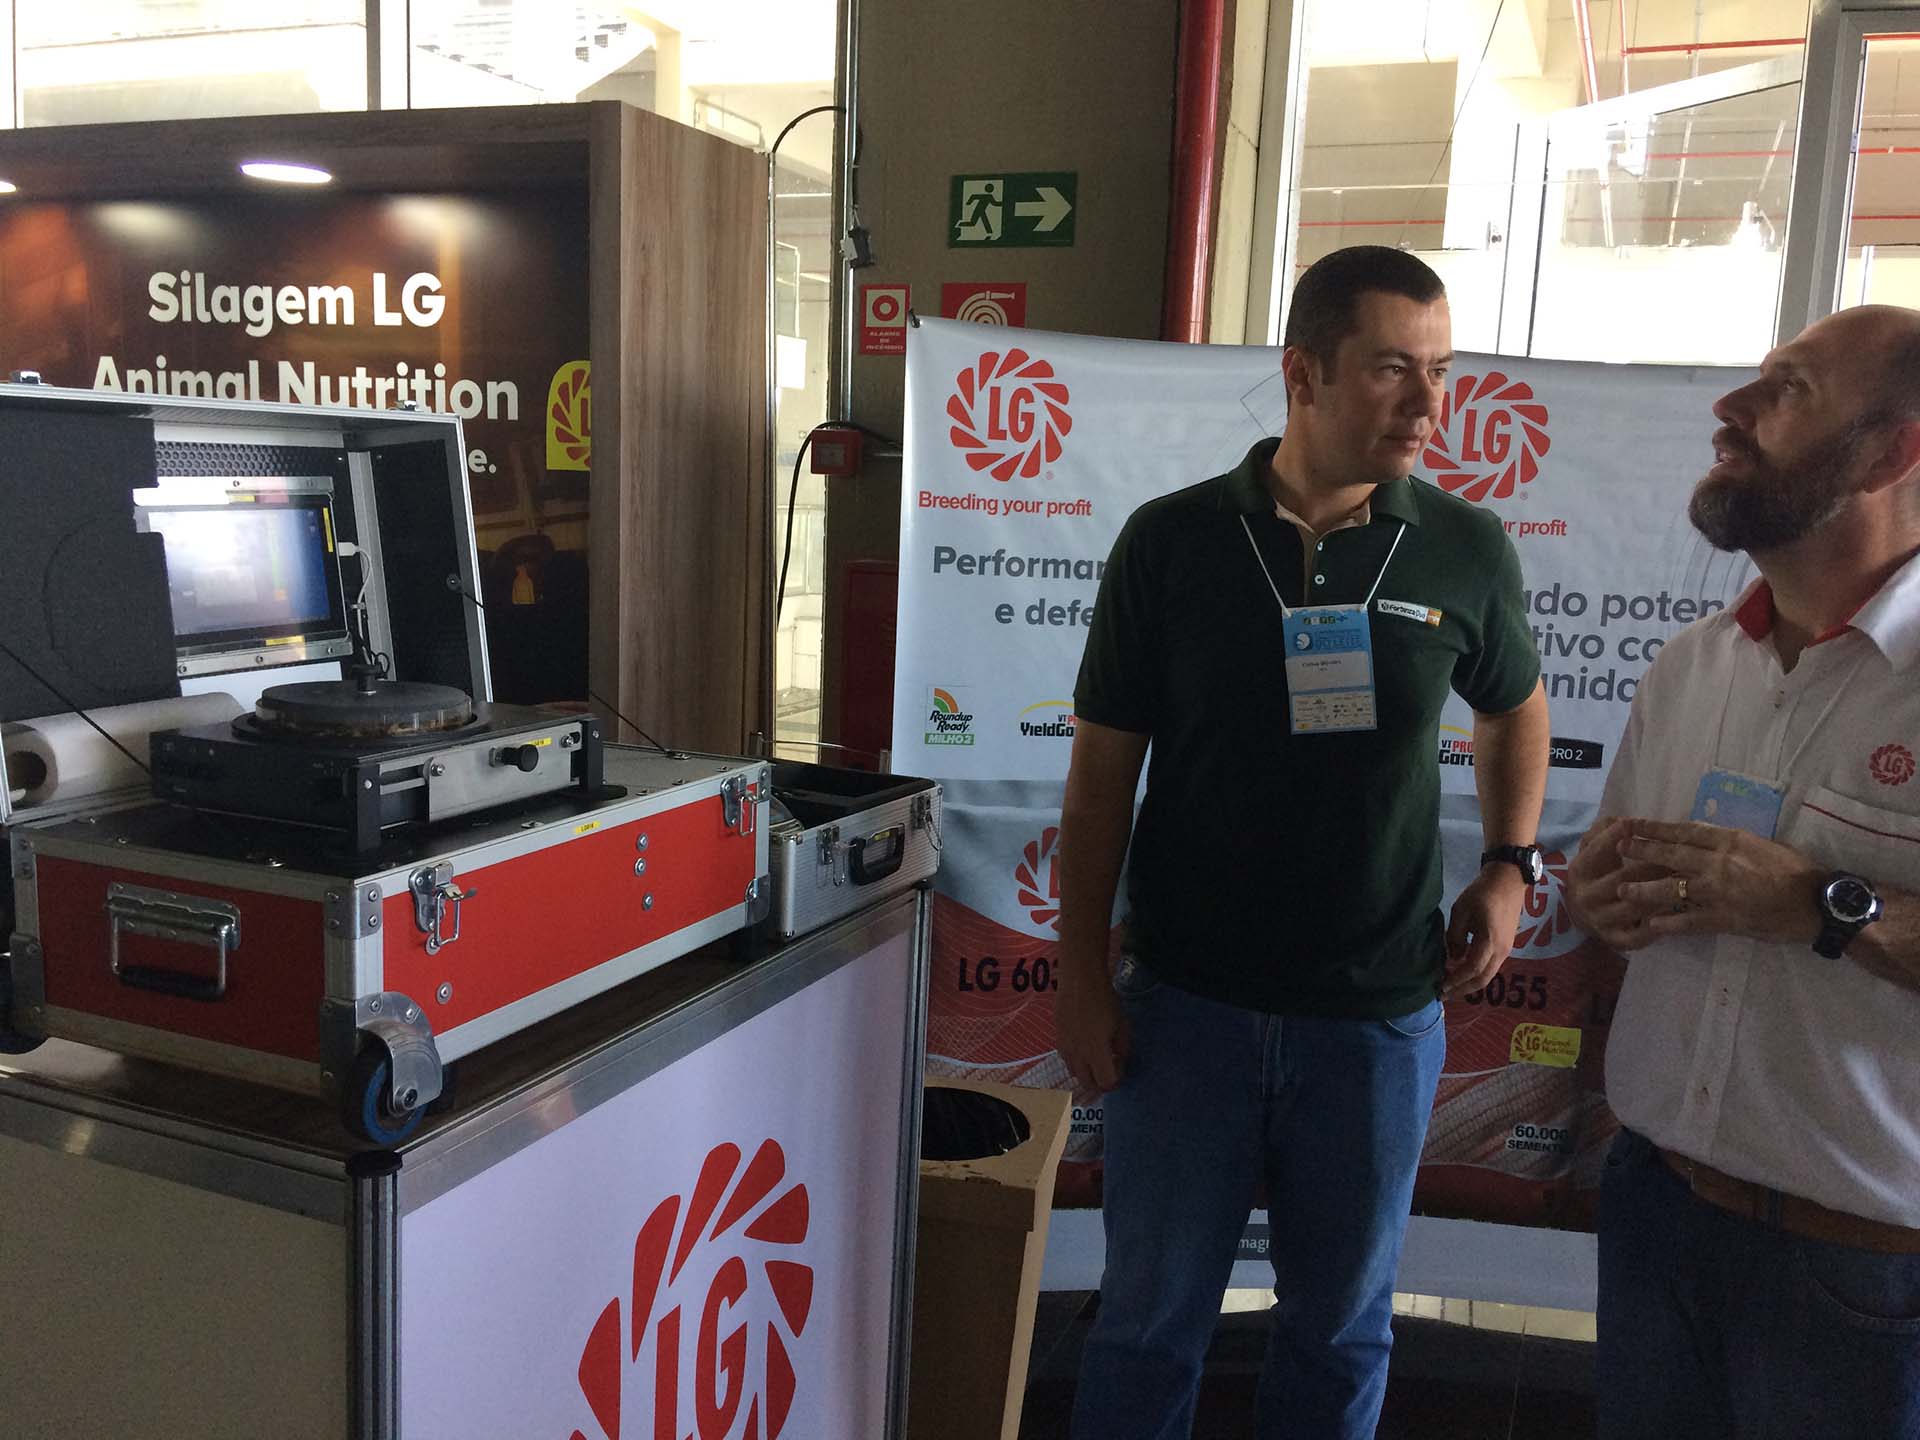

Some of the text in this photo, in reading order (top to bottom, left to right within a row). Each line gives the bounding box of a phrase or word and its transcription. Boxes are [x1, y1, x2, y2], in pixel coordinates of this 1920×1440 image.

[149, 270, 446, 337] Silagem LG
[93, 355, 518, 421] Animal Nutrition
[988, 386, 1035, 443] LG
[1461, 409, 1512, 464] LG
[918, 491, 1092, 518] Breeding your profit
[1519, 519, 1567, 538] profit
[995, 602, 1015, 624] e
[930, 710, 973, 725] Roundup
[936, 721, 970, 734] Ready
[1549, 748, 1584, 761] PRO 2
[958, 957, 1001, 992] LG
[1527, 1036, 1541, 1050] LG
[653, 1256, 748, 1440] LG
